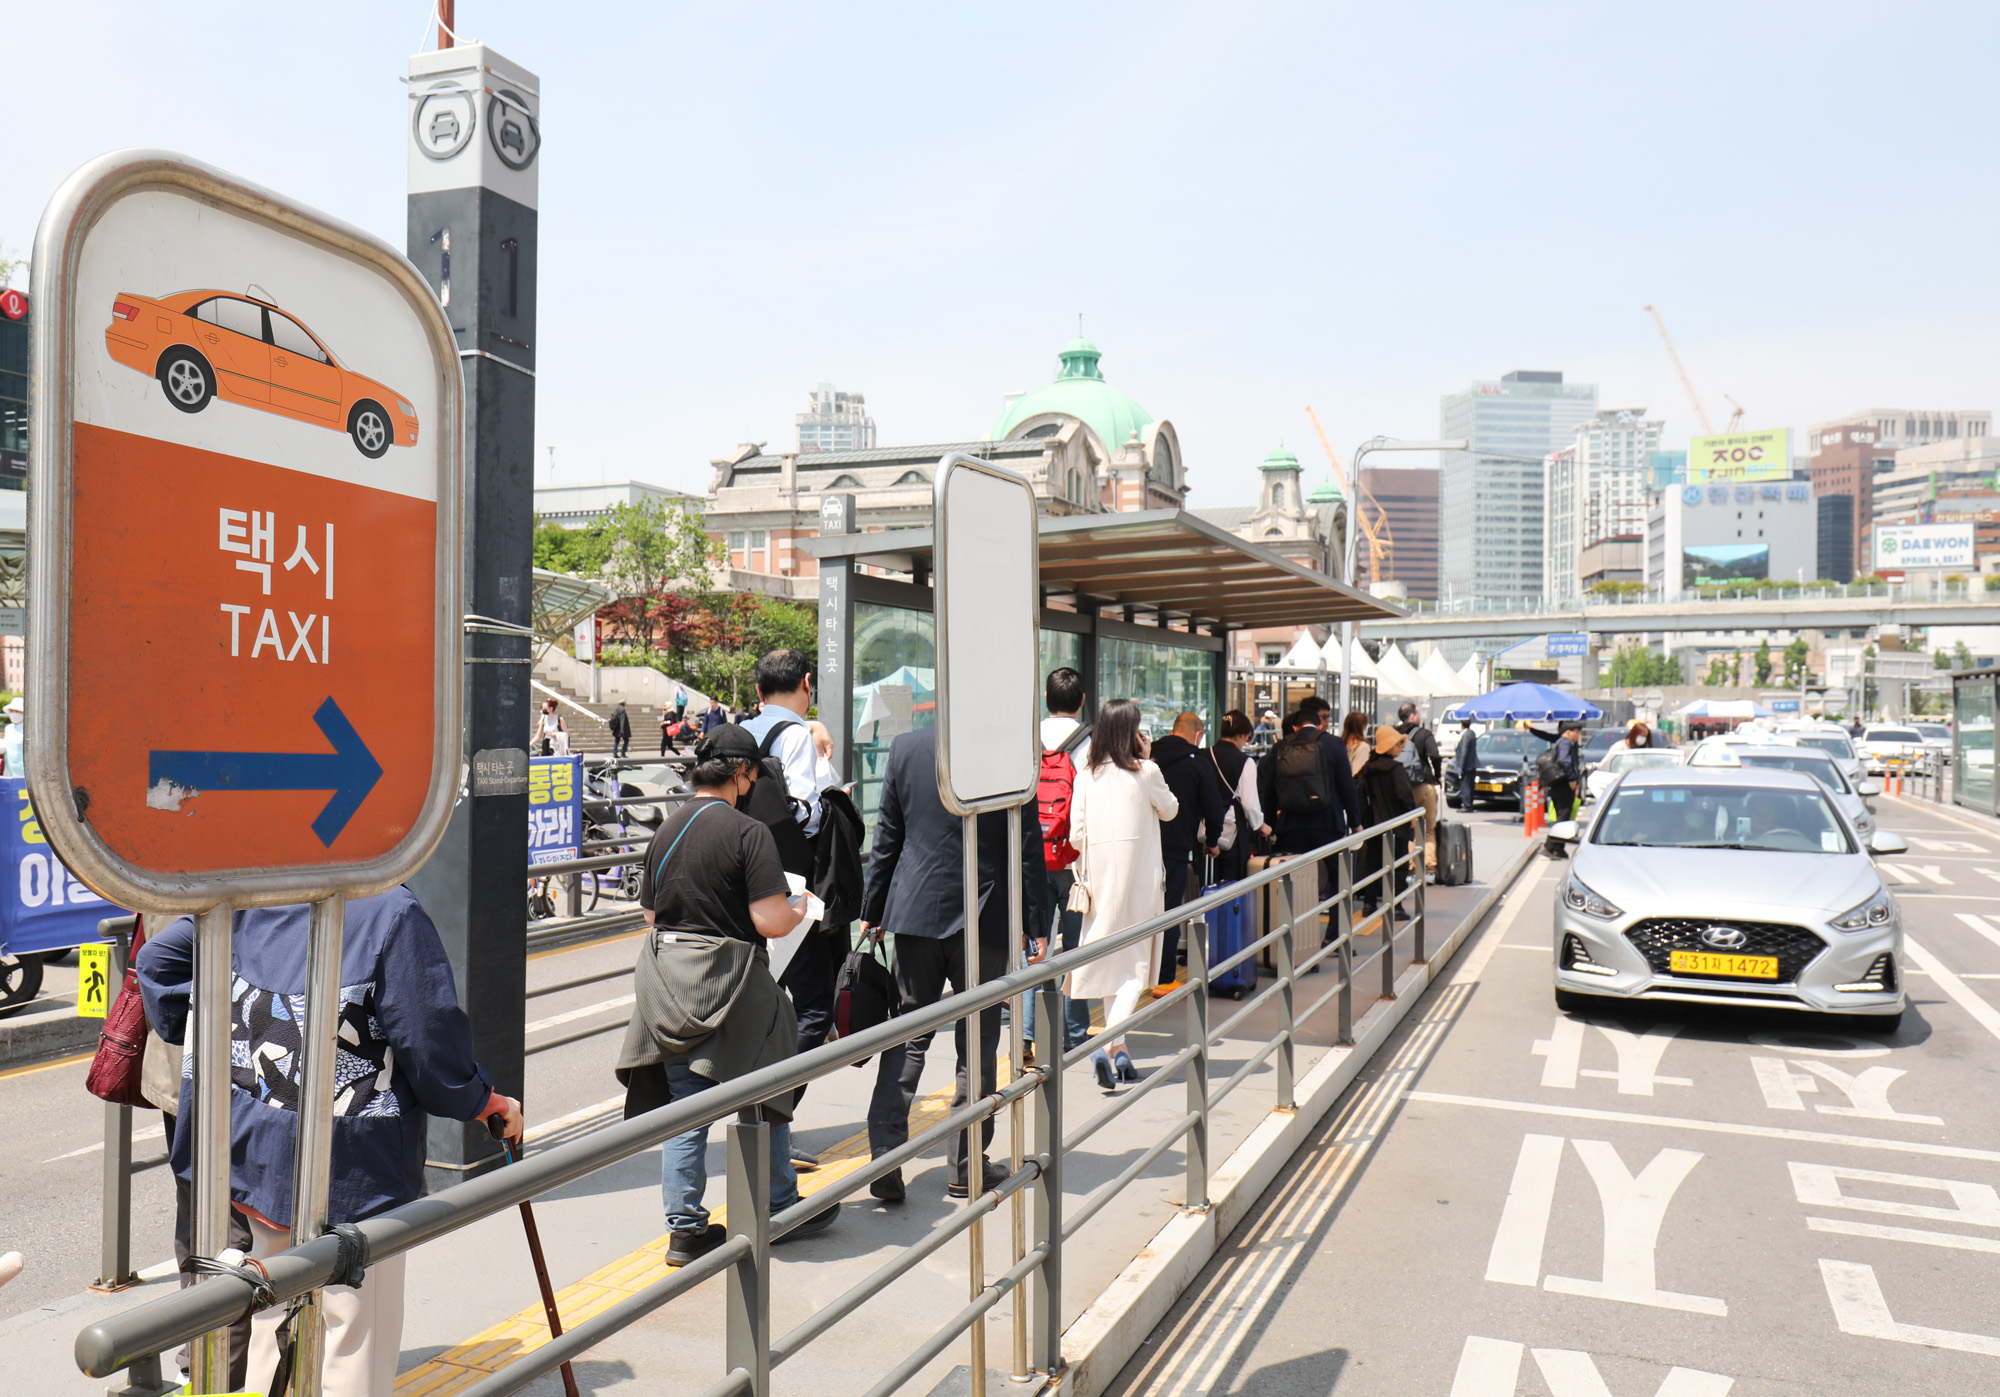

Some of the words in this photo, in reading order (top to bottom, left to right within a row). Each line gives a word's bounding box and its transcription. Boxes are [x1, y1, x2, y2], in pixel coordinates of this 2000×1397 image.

[823, 520, 842, 530] TAXI
[1901, 537, 1969, 550] DAEWON
[219, 507, 334, 600] 택시
[220, 603, 329, 664] TAXI
[476, 761, 490, 776] 택시
[491, 761, 505, 775] 타는
[506, 760, 514, 775] 곳
[476, 777, 488, 785] TAXI
[1727, 957, 1771, 975] 1472
